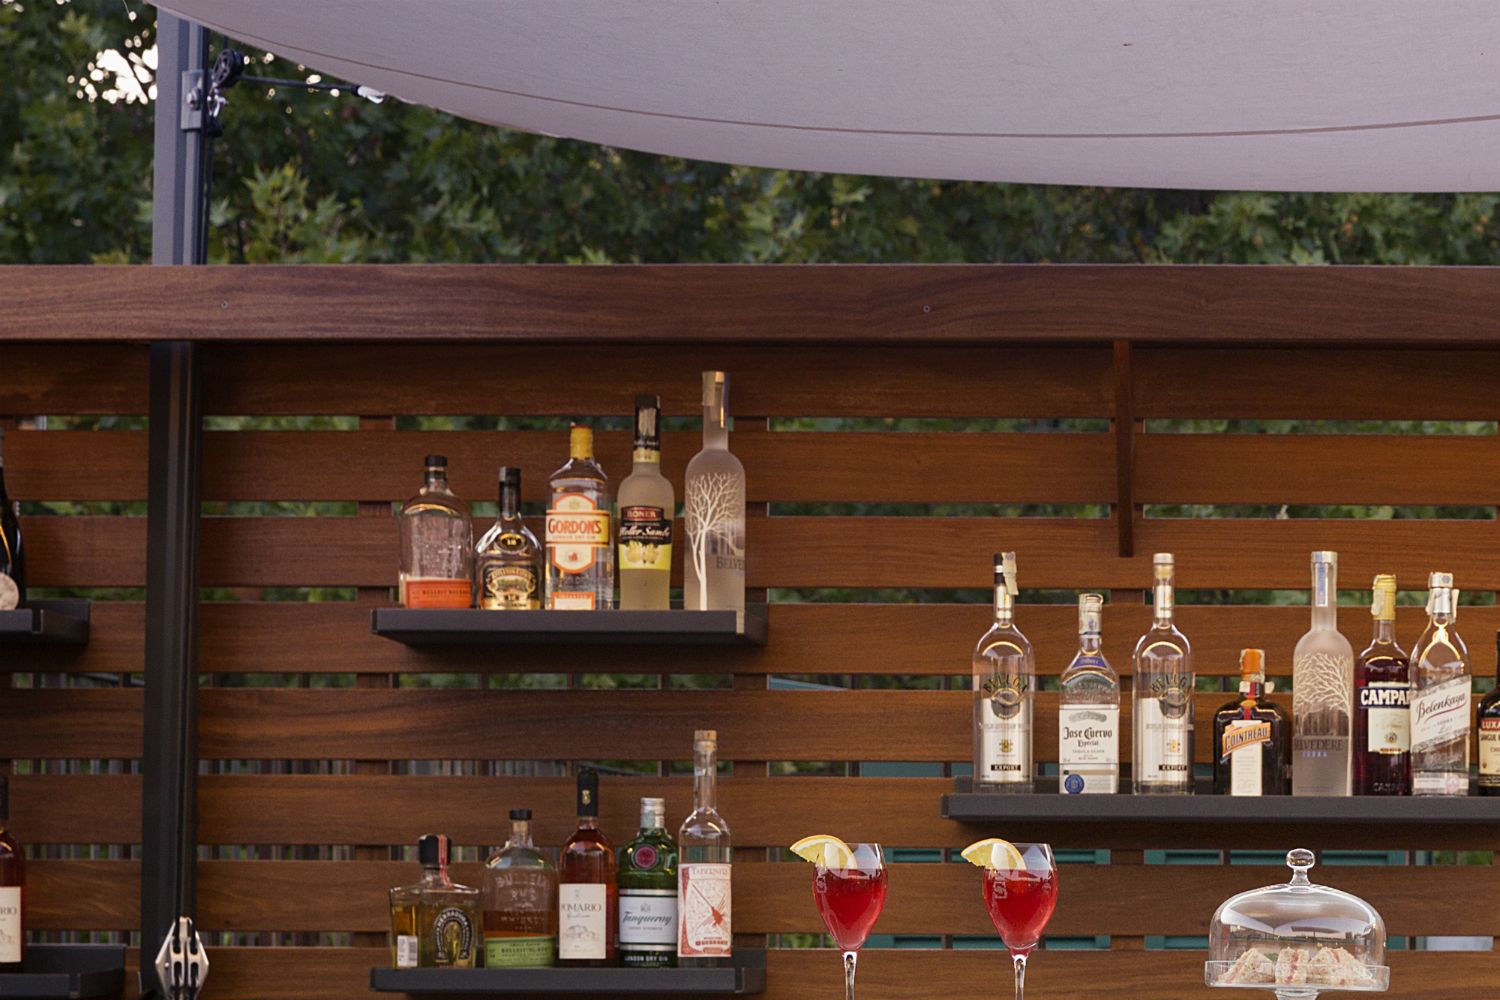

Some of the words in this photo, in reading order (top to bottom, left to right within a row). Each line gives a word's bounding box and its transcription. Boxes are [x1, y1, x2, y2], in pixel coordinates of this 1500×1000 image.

[1063, 726, 1082, 740] Jose
[1084, 726, 1113, 740] Cuervo
[1226, 727, 1268, 752] COINTREAU
[623, 911, 673, 926] Tanqueray
